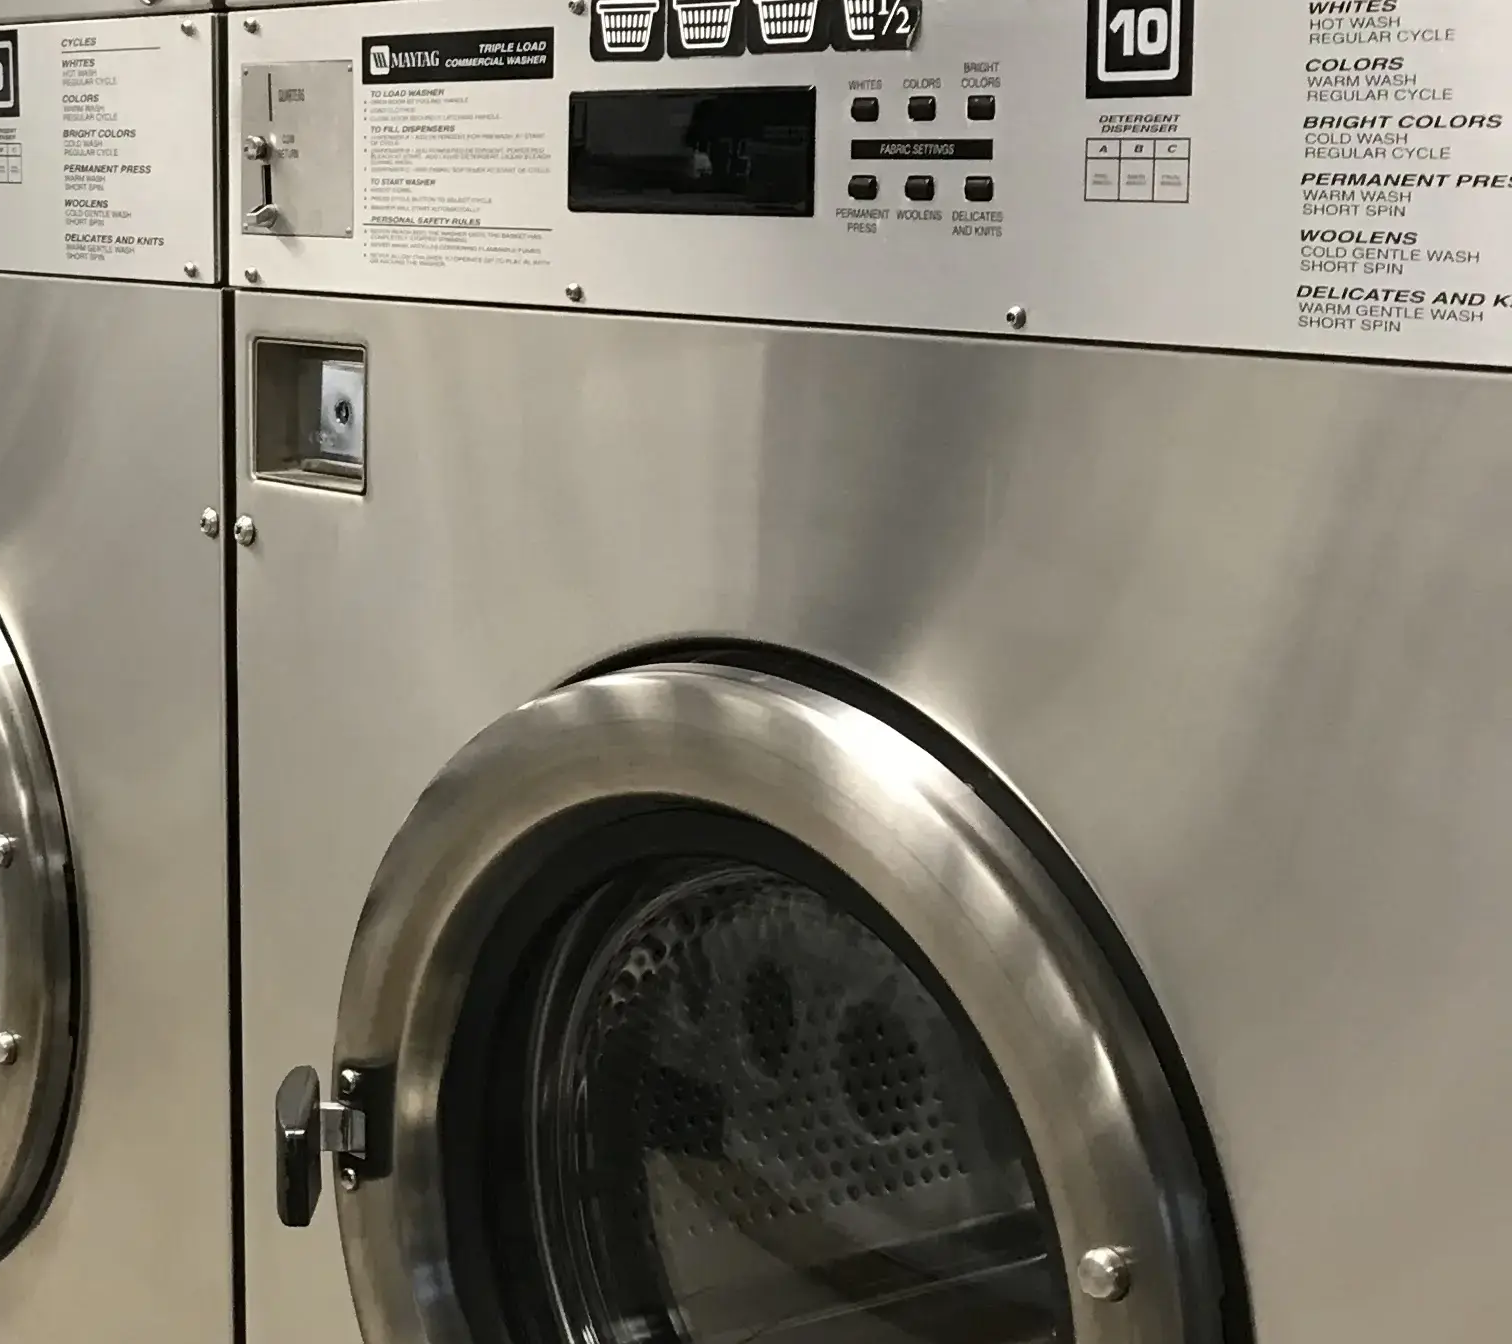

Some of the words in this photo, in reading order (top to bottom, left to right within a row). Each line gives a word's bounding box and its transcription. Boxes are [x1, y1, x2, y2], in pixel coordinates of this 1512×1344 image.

[1309, 18, 1345, 30] HOT
[1350, 16, 1401, 28] WASH
[1109, 7, 1168, 57] 10
[1309, 31, 1391, 45] REGULAR
[1397, 28, 1456, 42] CYCLE
[61, 37, 96, 47] CYCLES
[479, 42, 514, 54] TRIPLE
[516, 41, 546, 52] LOAD
[62, 59, 95, 67] WHITES
[391, 50, 439, 68] MAYTAG
[445, 56, 504, 67] COMMERCIAL
[506, 55, 546, 65] WASHER
[1306, 56, 1404, 72] COLORS
[963, 62, 999, 72] BRIGHT
[849, 79, 882, 90] WHITES
[903, 78, 942, 89] COLORS
[961, 77, 1001, 88] COLORS
[1307, 75, 1360, 87] WARM
[1365, 74, 1417, 86] WASH
[62, 94, 99, 103] COLORS
[1307, 90, 1389, 102] REGULAR
[1394, 88, 1453, 100] CYCLE
[1099, 114, 1180, 123] DETERGENT
[1303, 115, 1393, 129] BRIGHT
[1398, 115, 1503, 129] COLORS
[63, 129, 96, 138] BRIGHT
[98, 129, 136, 138] COLORS
[1101, 125, 1178, 133] DISPENSER
[1305, 133, 1351, 144] COLD
[1357, 133, 1408, 145] WASH
[880, 144, 911, 154] FABRIC
[913, 144, 955, 155] SETTINGS
[1099, 144, 1107, 153] A
[1134, 144, 1143, 153] B
[1167, 144, 1177, 153] C
[1305, 147, 1386, 159] REGULAR
[1392, 147, 1451, 159] CYCLE
[64, 164, 118, 173] PERMANENT
[120, 165, 152, 174] PRESS
[1300, 173, 1451, 187] PERMANENT
[1302, 190, 1355, 202] WARM
[1360, 191, 1412, 203] WASH
[65, 199, 108, 208] WOOLENS
[836, 209, 890, 219] PERMANENT
[897, 210, 942, 220] WOOLENS
[952, 211, 1003, 222] DELICATES
[1302, 204, 1360, 216] SHORT
[1366, 205, 1406, 217] SPIN
[847, 223, 877, 233] PRESS
[952, 226, 972, 236] AND
[975, 226, 1002, 237] KNITS
[65, 234, 113, 243] DELICATES
[115, 236, 135, 244] AND
[137, 237, 165, 246] KNITS
[1300, 230, 1418, 245] WOOLENS
[1301, 246, 1347, 258] COLD
[1352, 248, 1422, 262] GENTLE
[1427, 250, 1480, 263] WASH
[1300, 260, 1359, 273] SHORT
[1364, 263, 1404, 275] SPIN
[1296, 285, 1426, 303] DELICATES
[1431, 292, 1486, 306] AND
[1298, 302, 1350, 315] WARM
[1355, 305, 1424, 319] GENTLE
[1430, 309, 1484, 322] WASH
[1298, 316, 1356, 329] SHORT
[1360, 319, 1401, 332] SPIN
